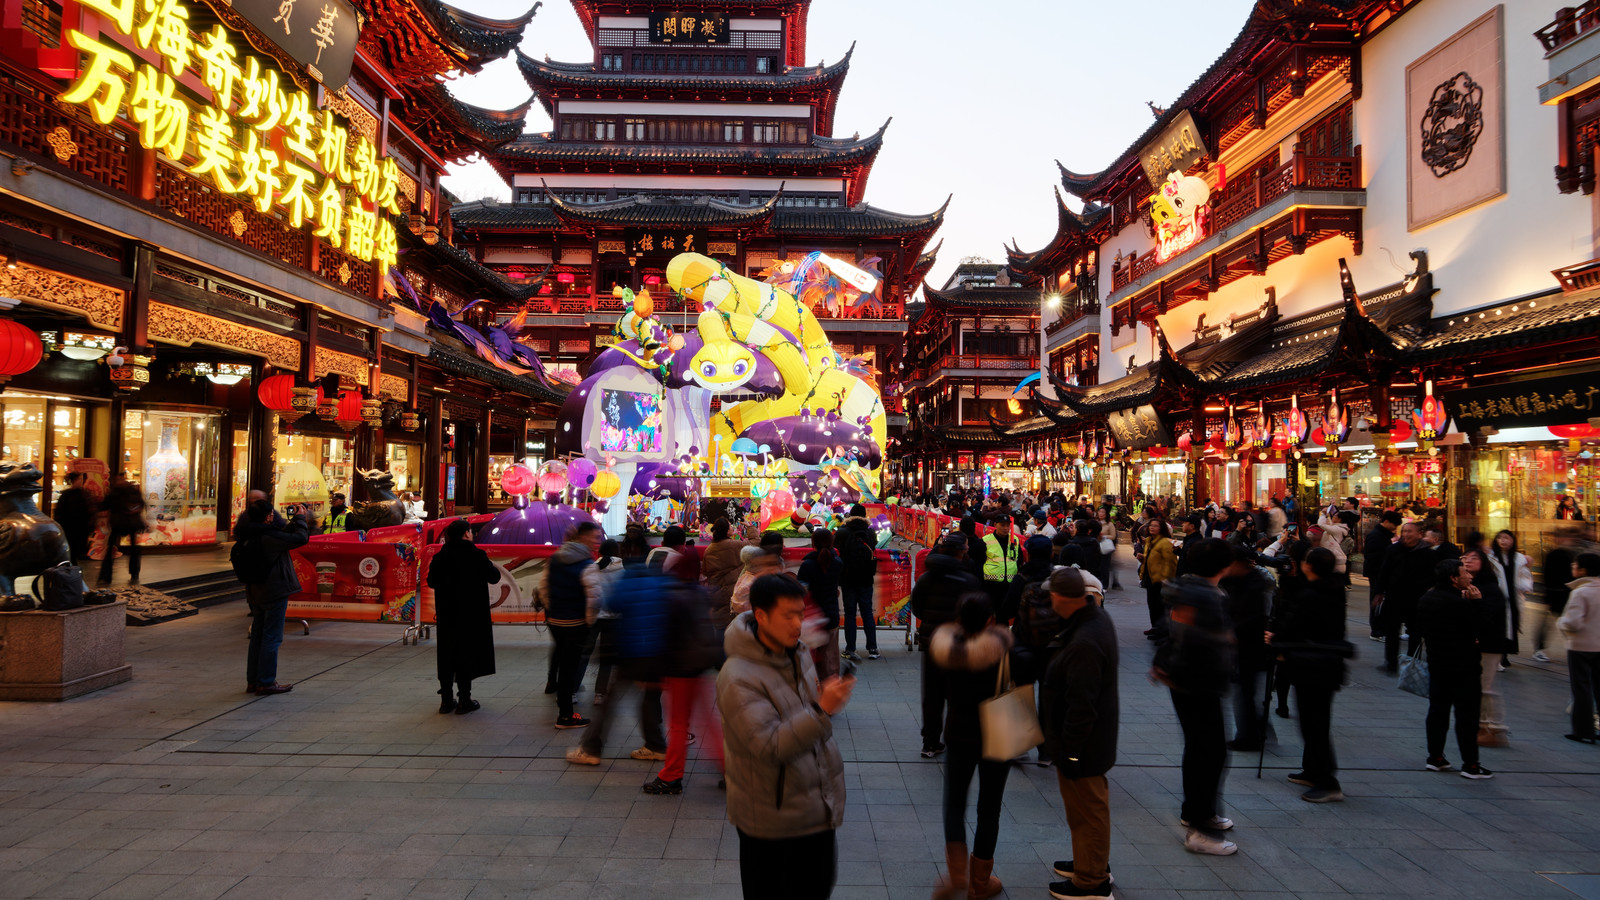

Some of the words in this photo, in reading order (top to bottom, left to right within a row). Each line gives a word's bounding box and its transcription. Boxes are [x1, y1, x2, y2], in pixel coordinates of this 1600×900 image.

[62, 29, 399, 276] 万物美好不负韶华
[74, 0, 401, 215] 山海奇妙生机勃发
